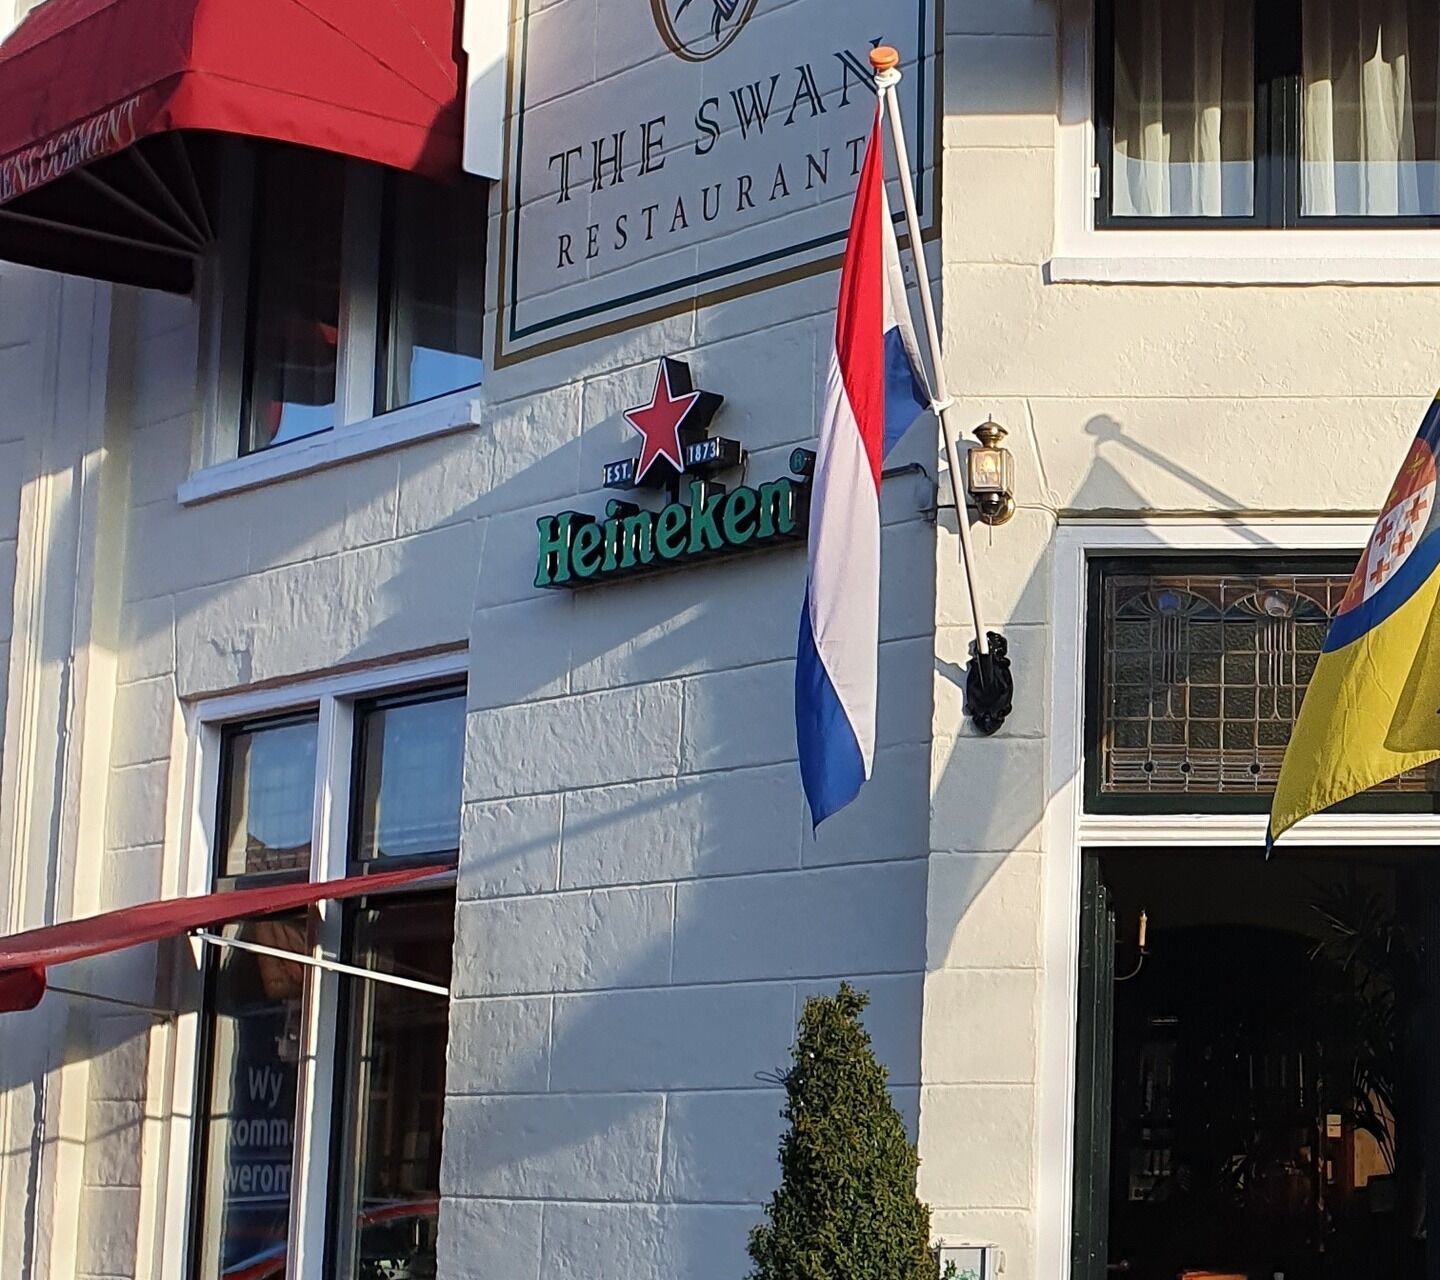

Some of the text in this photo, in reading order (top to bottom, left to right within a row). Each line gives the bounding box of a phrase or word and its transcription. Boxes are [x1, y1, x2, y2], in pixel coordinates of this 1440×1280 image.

[549, 36, 884, 204] THE SWAN
[556, 136, 866, 268] RESTAURANT
[606, 441, 716, 484] EST. 1873
[534, 476, 796, 587] Heineken
[248, 1065, 283, 1108] Wy
